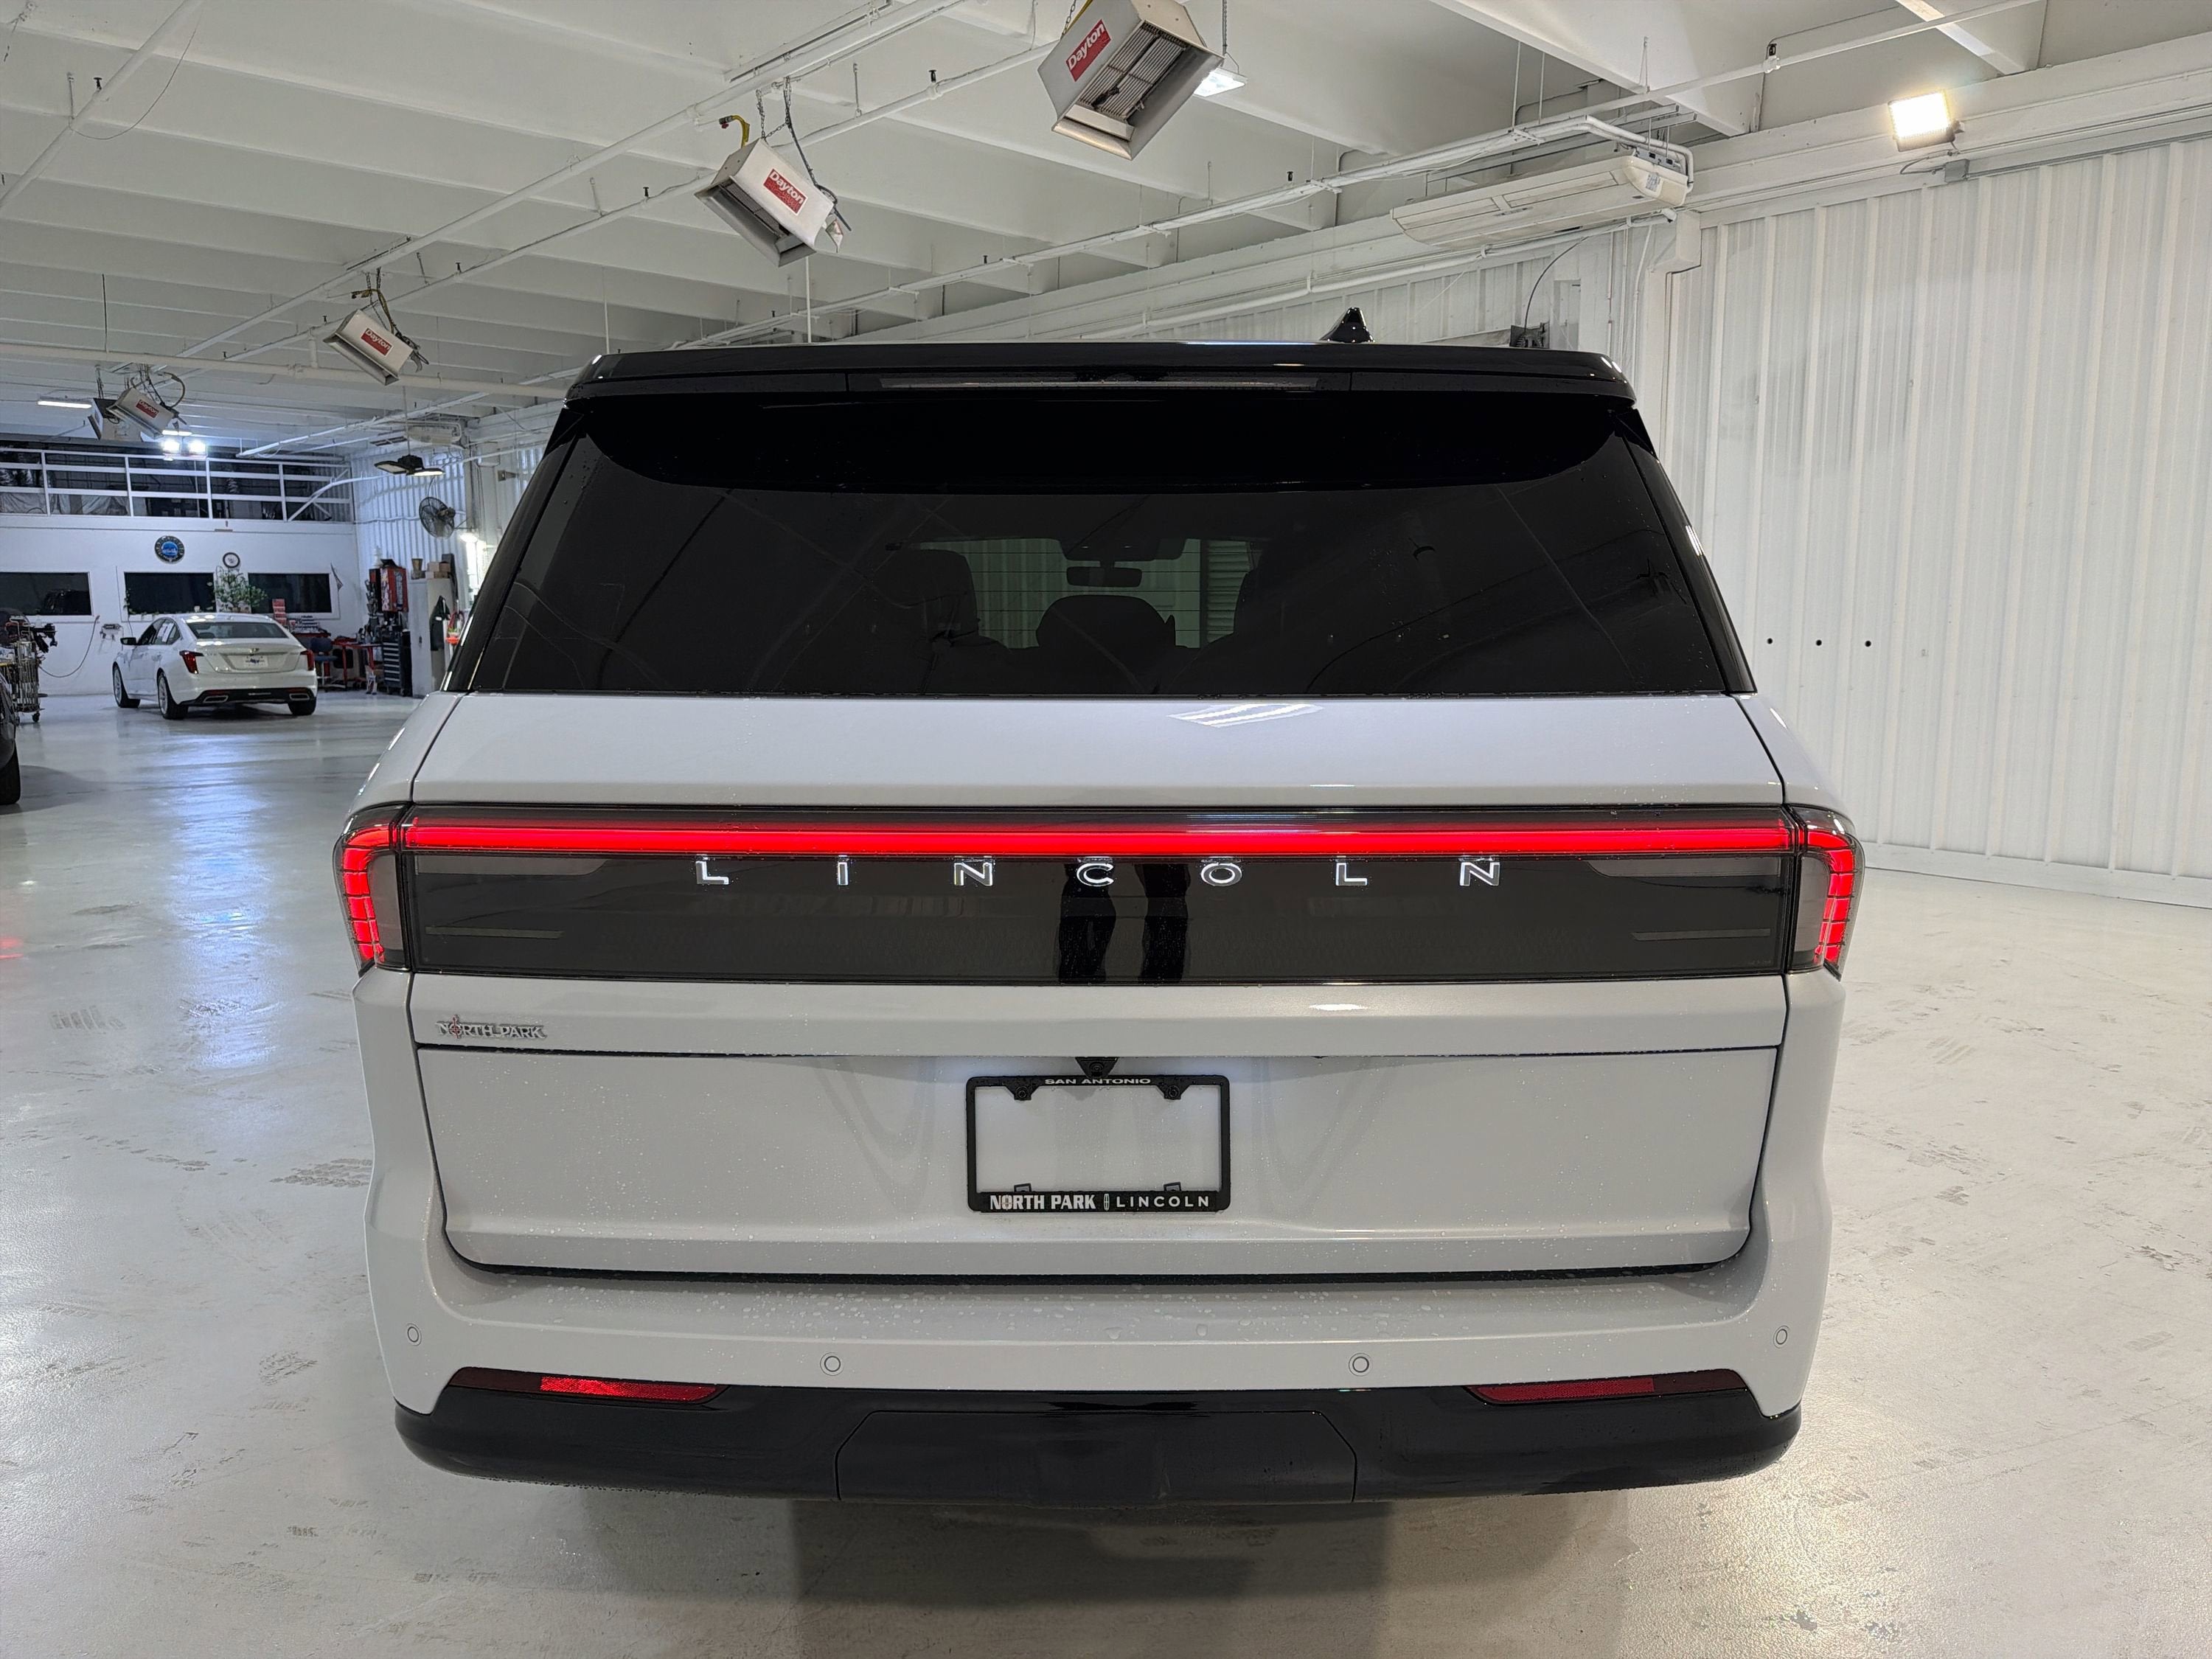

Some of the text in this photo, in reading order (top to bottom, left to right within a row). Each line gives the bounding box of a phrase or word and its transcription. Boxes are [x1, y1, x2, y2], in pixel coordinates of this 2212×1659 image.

[1068, 24, 1105, 70] Dayton
[769, 171, 804, 204] Dayton
[365, 330, 391, 350] Dayton
[695, 861, 1500, 887] LINCOLN
[436, 1020, 547, 1039] NORTH PARK
[990, 1194, 1209, 1211] NORTH PARK LINCOLN
